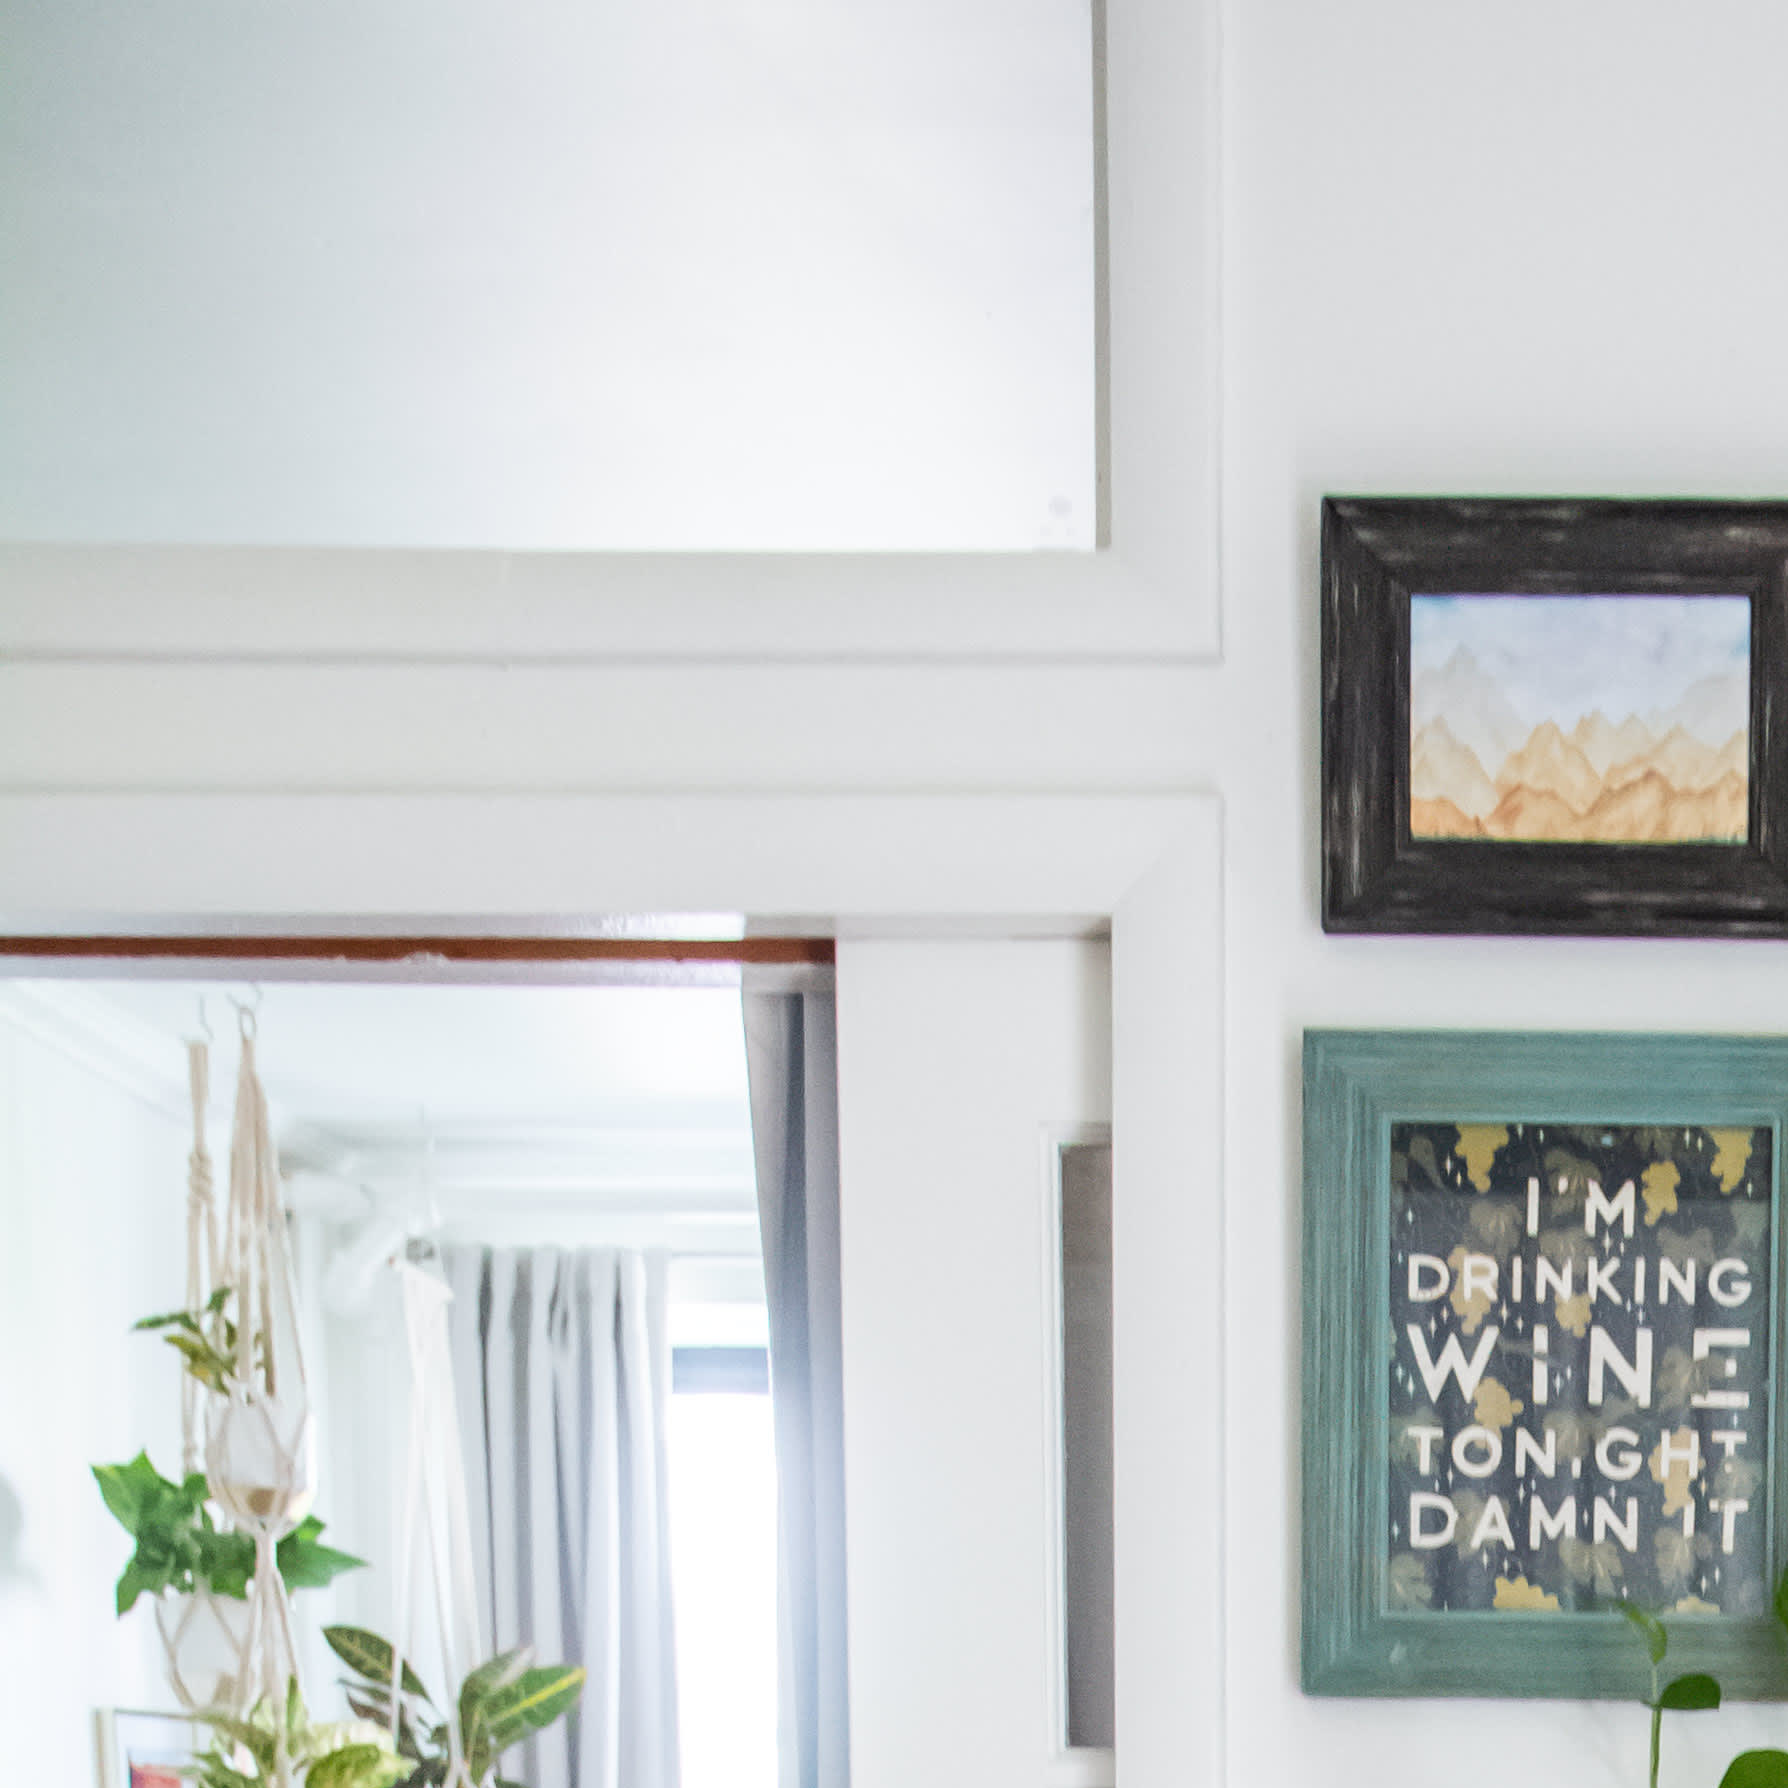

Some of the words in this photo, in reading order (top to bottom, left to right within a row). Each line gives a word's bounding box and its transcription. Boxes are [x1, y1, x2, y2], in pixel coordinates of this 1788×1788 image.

[1526, 1176, 1636, 1238] I'M
[1407, 1253, 1753, 1307] DRINKING
[1406, 1323, 1751, 1409] WINE
[1408, 1493, 1639, 1552] DAMN
[1683, 1499, 1750, 1554] IT
